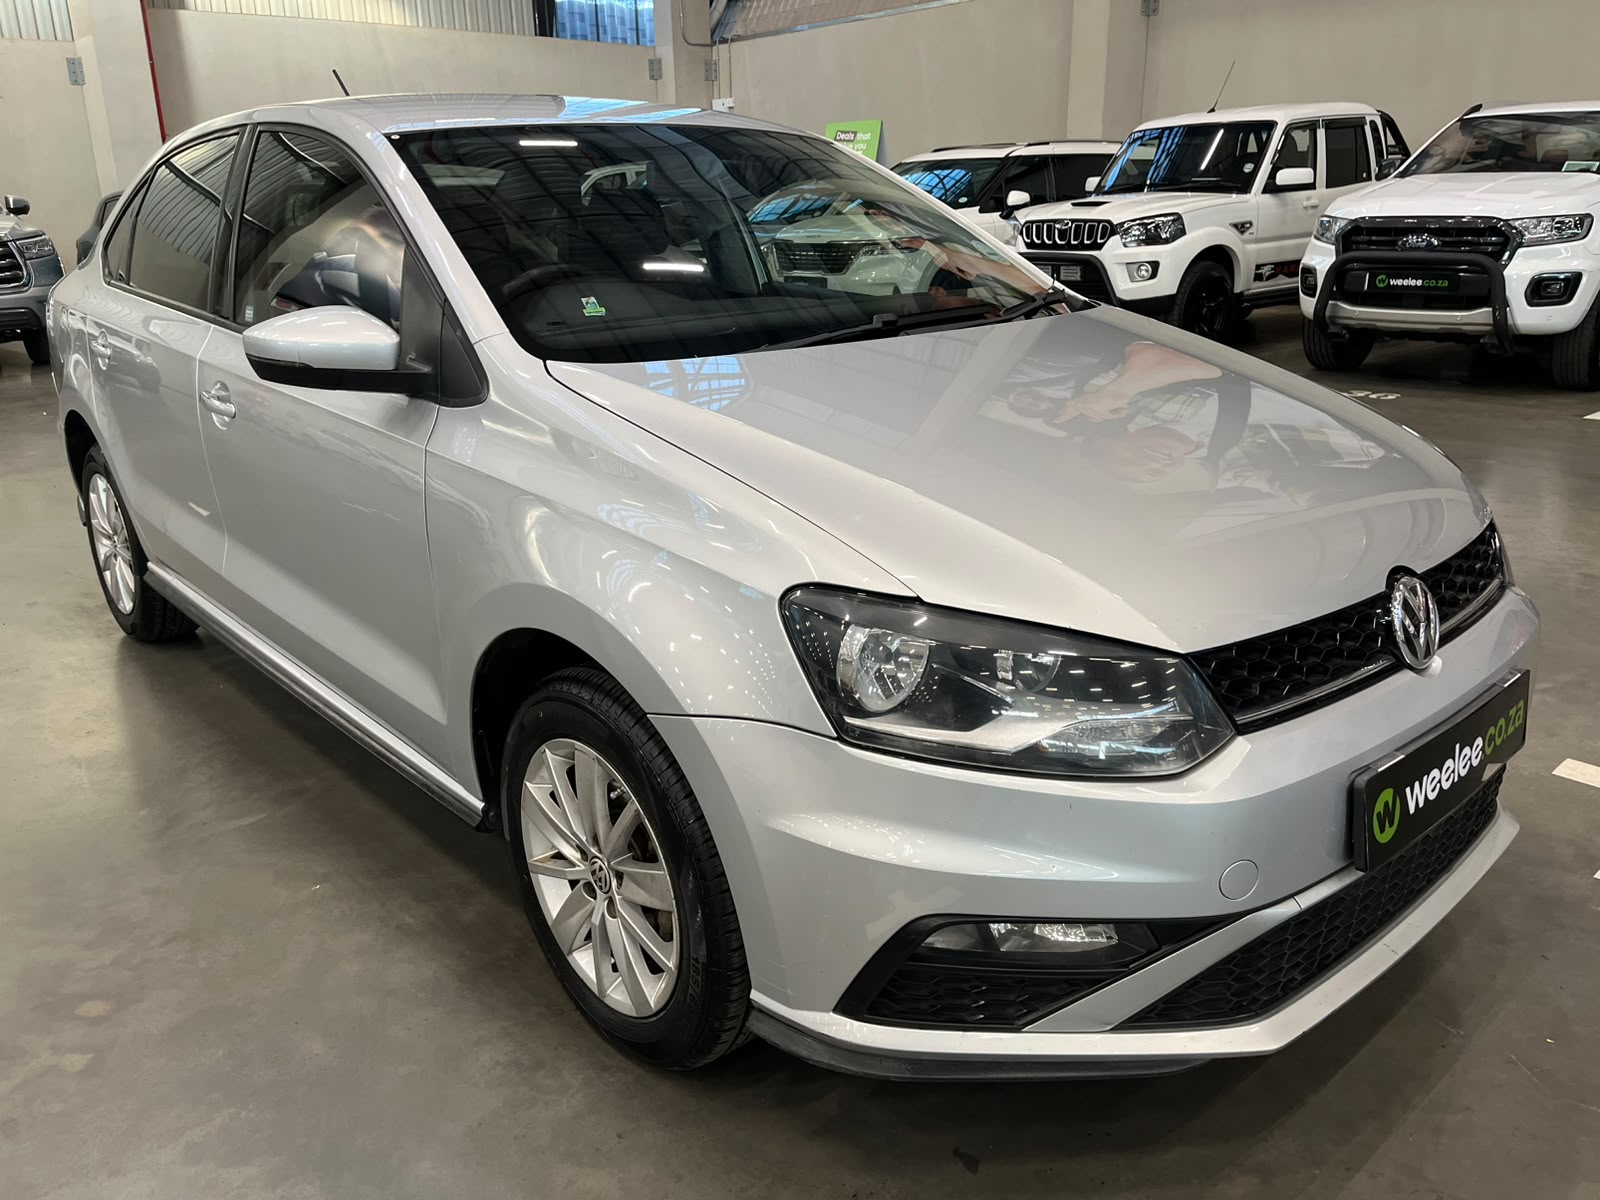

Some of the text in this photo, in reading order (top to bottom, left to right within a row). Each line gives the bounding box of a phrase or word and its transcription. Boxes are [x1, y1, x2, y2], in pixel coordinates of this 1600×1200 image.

[836, 132, 855, 140] Deals
[854, 143, 866, 151] you
[1389, 277, 1449, 287] weelee.co.za
[1405, 700, 1525, 815] weelee.co.za
